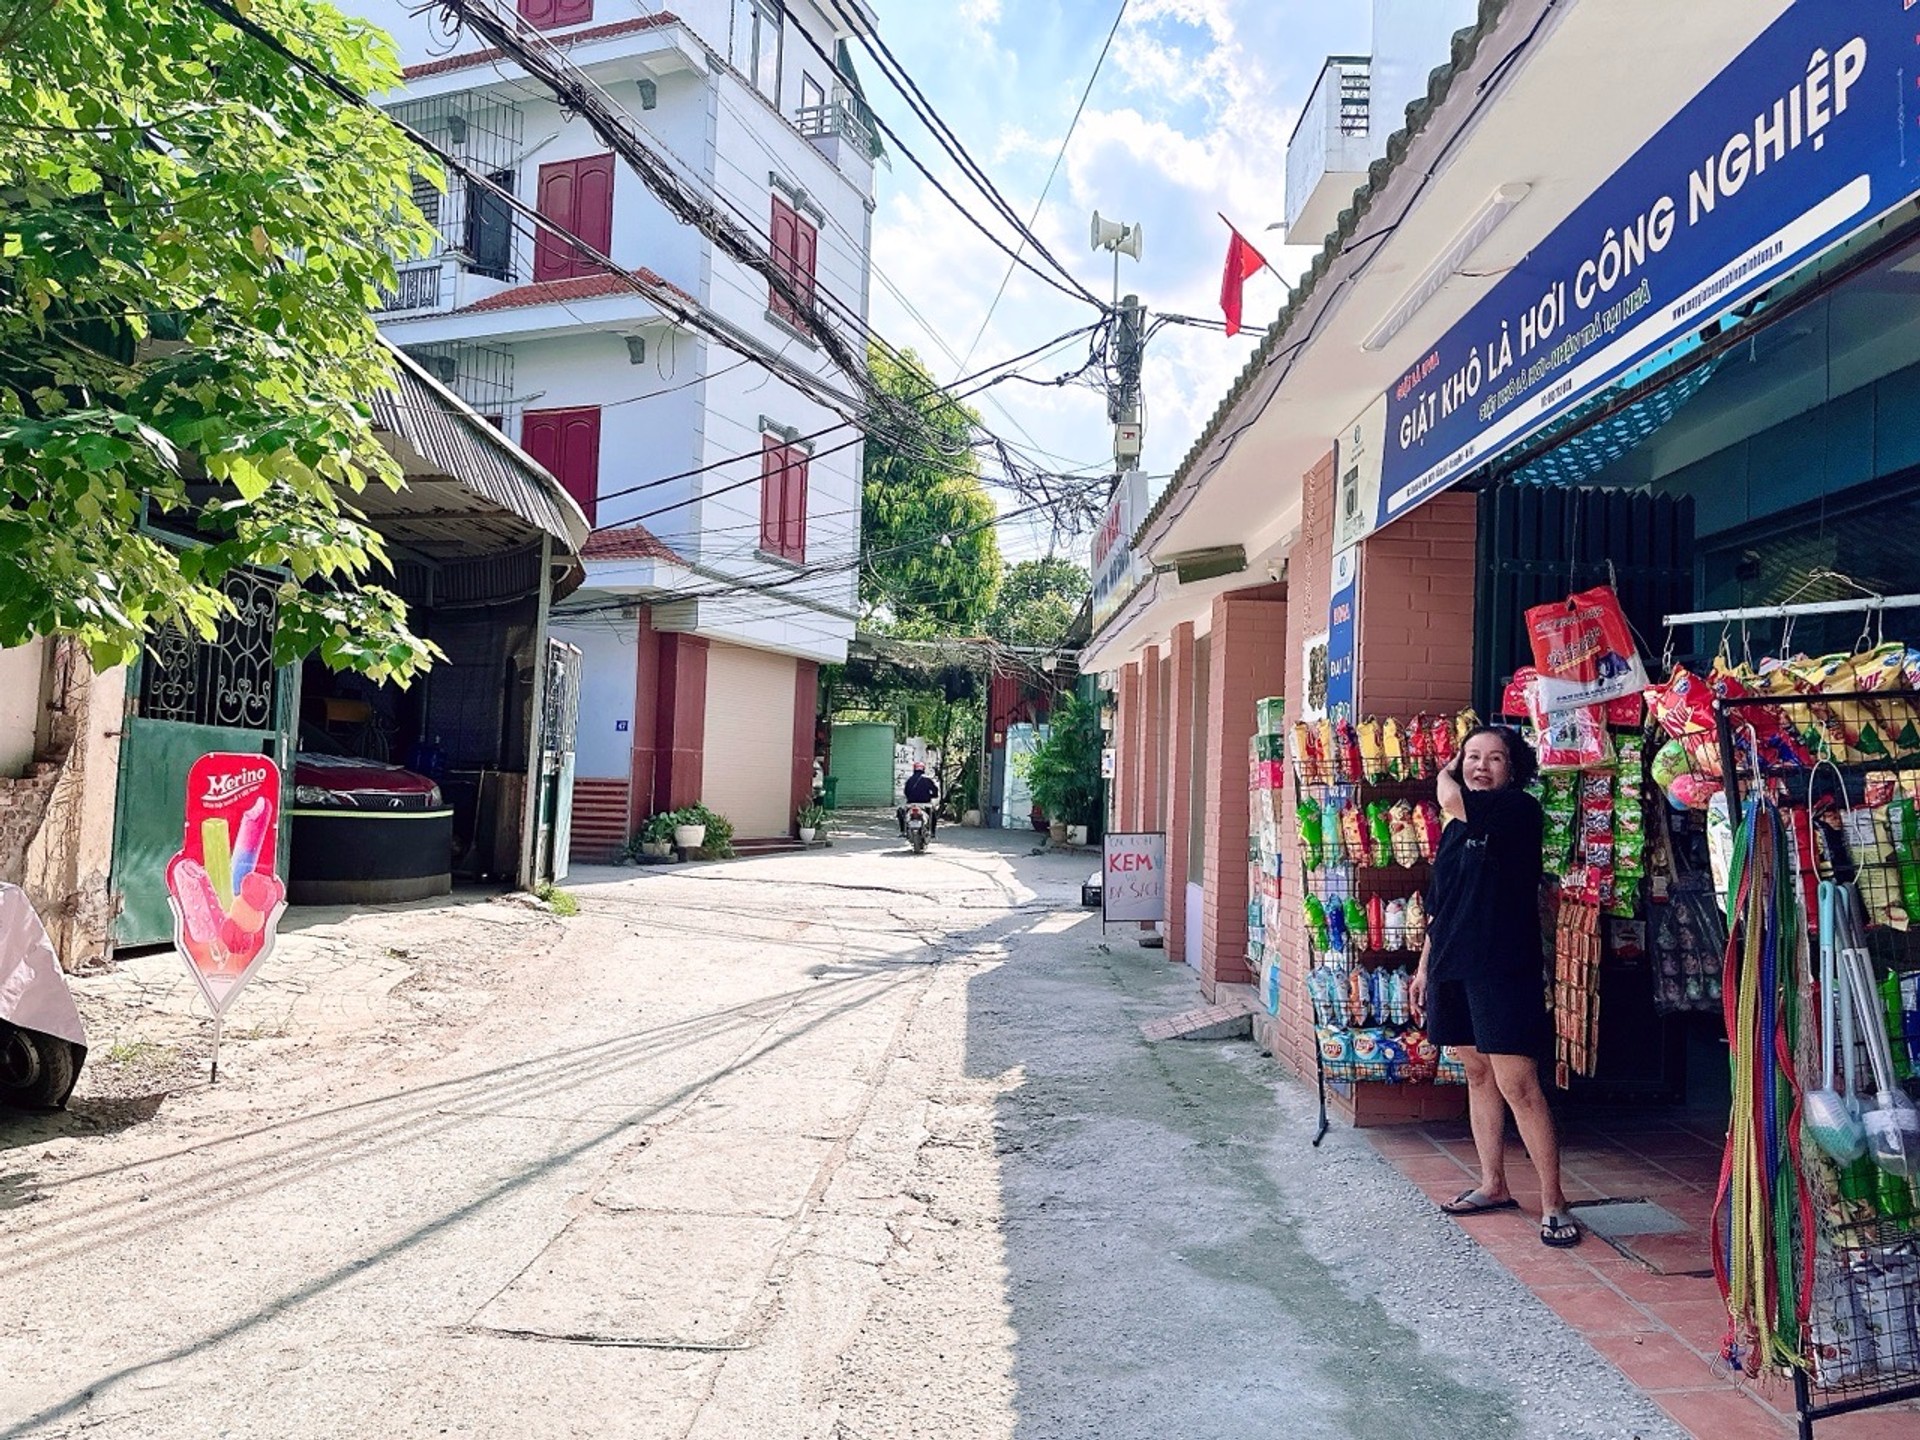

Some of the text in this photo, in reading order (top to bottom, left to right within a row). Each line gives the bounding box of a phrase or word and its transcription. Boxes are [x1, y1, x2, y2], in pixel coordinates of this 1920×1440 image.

[1400, 390, 1437, 450] GIẶT
[1442, 346, 1482, 419] KHÔ
[1488, 320, 1513, 382] LÀ
[1520, 281, 1565, 357] HƠI
[1574, 197, 1676, 309] CÔNG
[1688, 36, 1867, 227] NGHIỆP
[1551, 335, 1581, 370] NHẬN
[1581, 311, 1602, 348] TRẢ
[1602, 302, 1622, 335] TẠI
[1623, 278, 1652, 321] NHÀ
[207, 767, 267, 796] Merino
[1109, 853, 1153, 873] KEM
